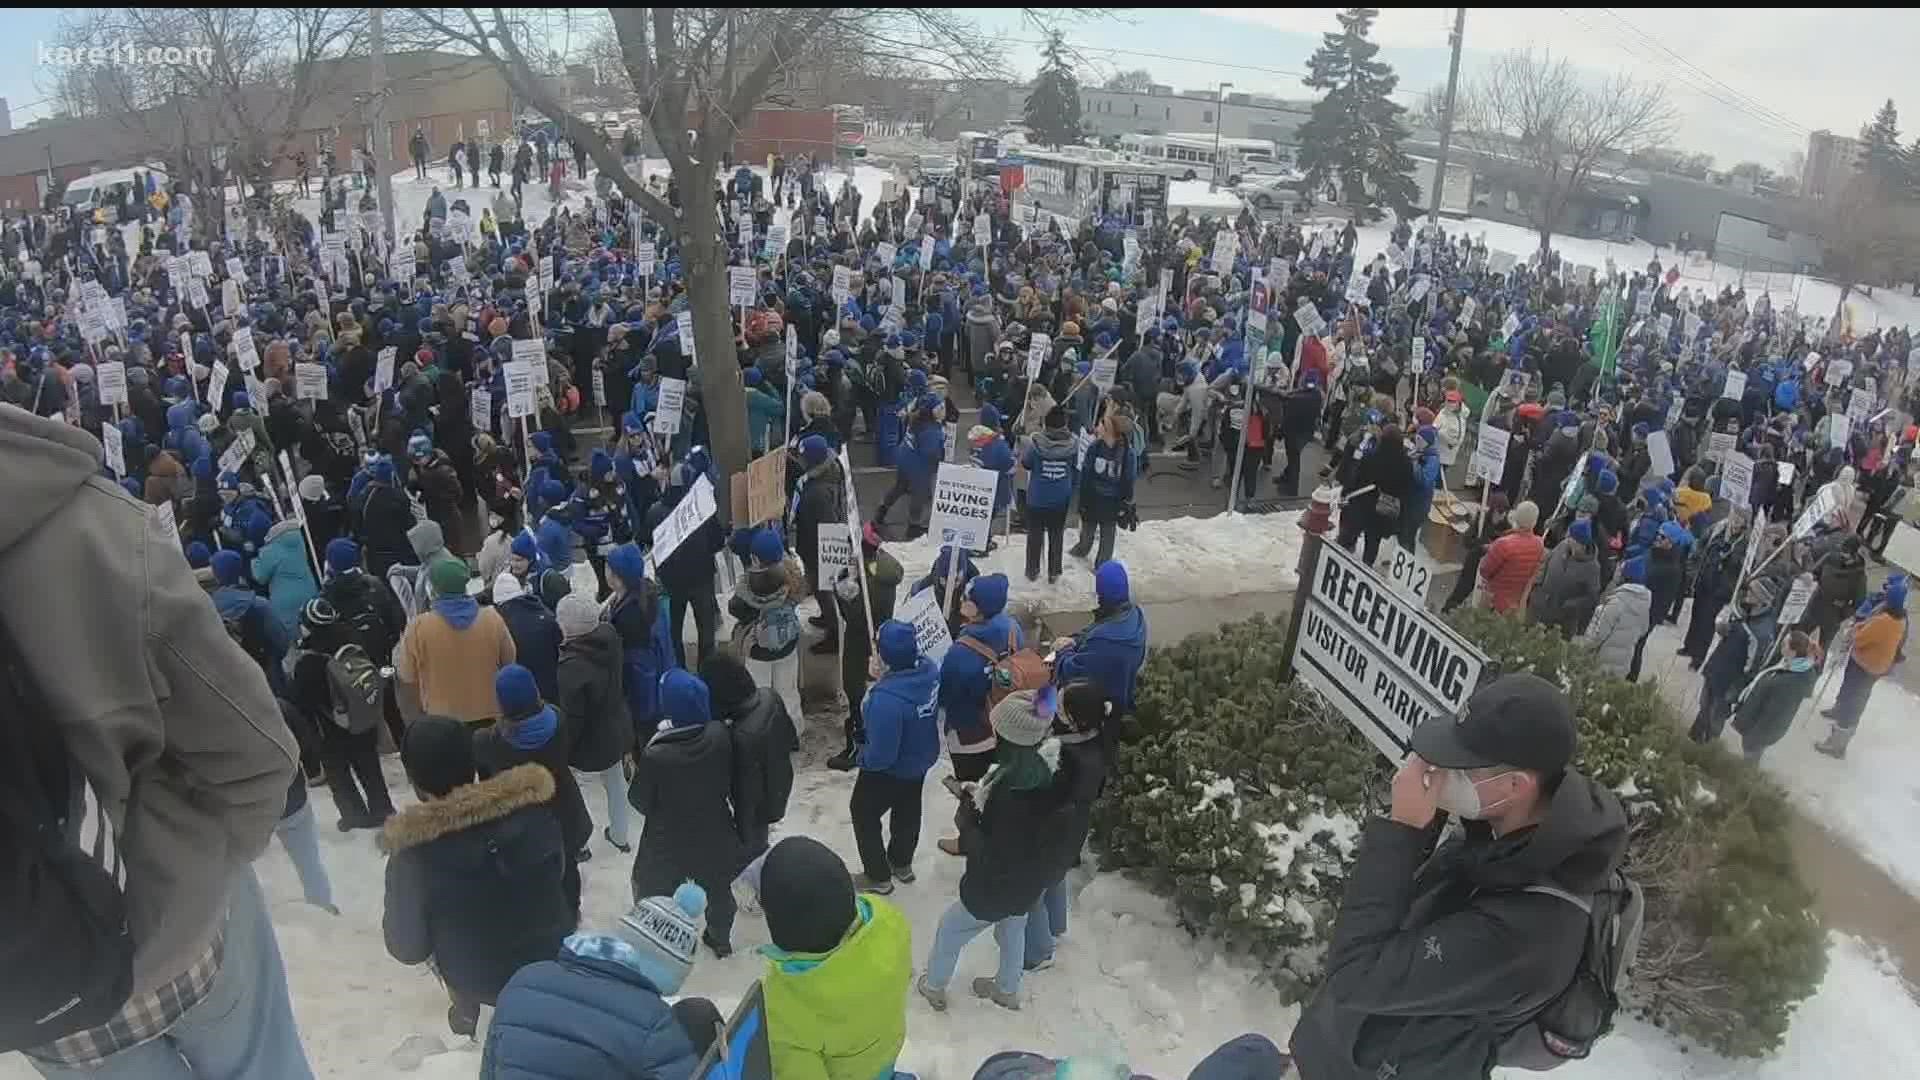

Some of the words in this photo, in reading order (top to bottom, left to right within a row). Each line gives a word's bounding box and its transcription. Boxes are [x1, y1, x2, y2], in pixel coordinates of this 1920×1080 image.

[936, 502, 988, 519] WAGES
[939, 489, 989, 506] LIVING
[1392, 551, 1428, 597] 812
[1306, 611, 1368, 683] VISITOR
[1320, 556, 1469, 705] RECEIVING
